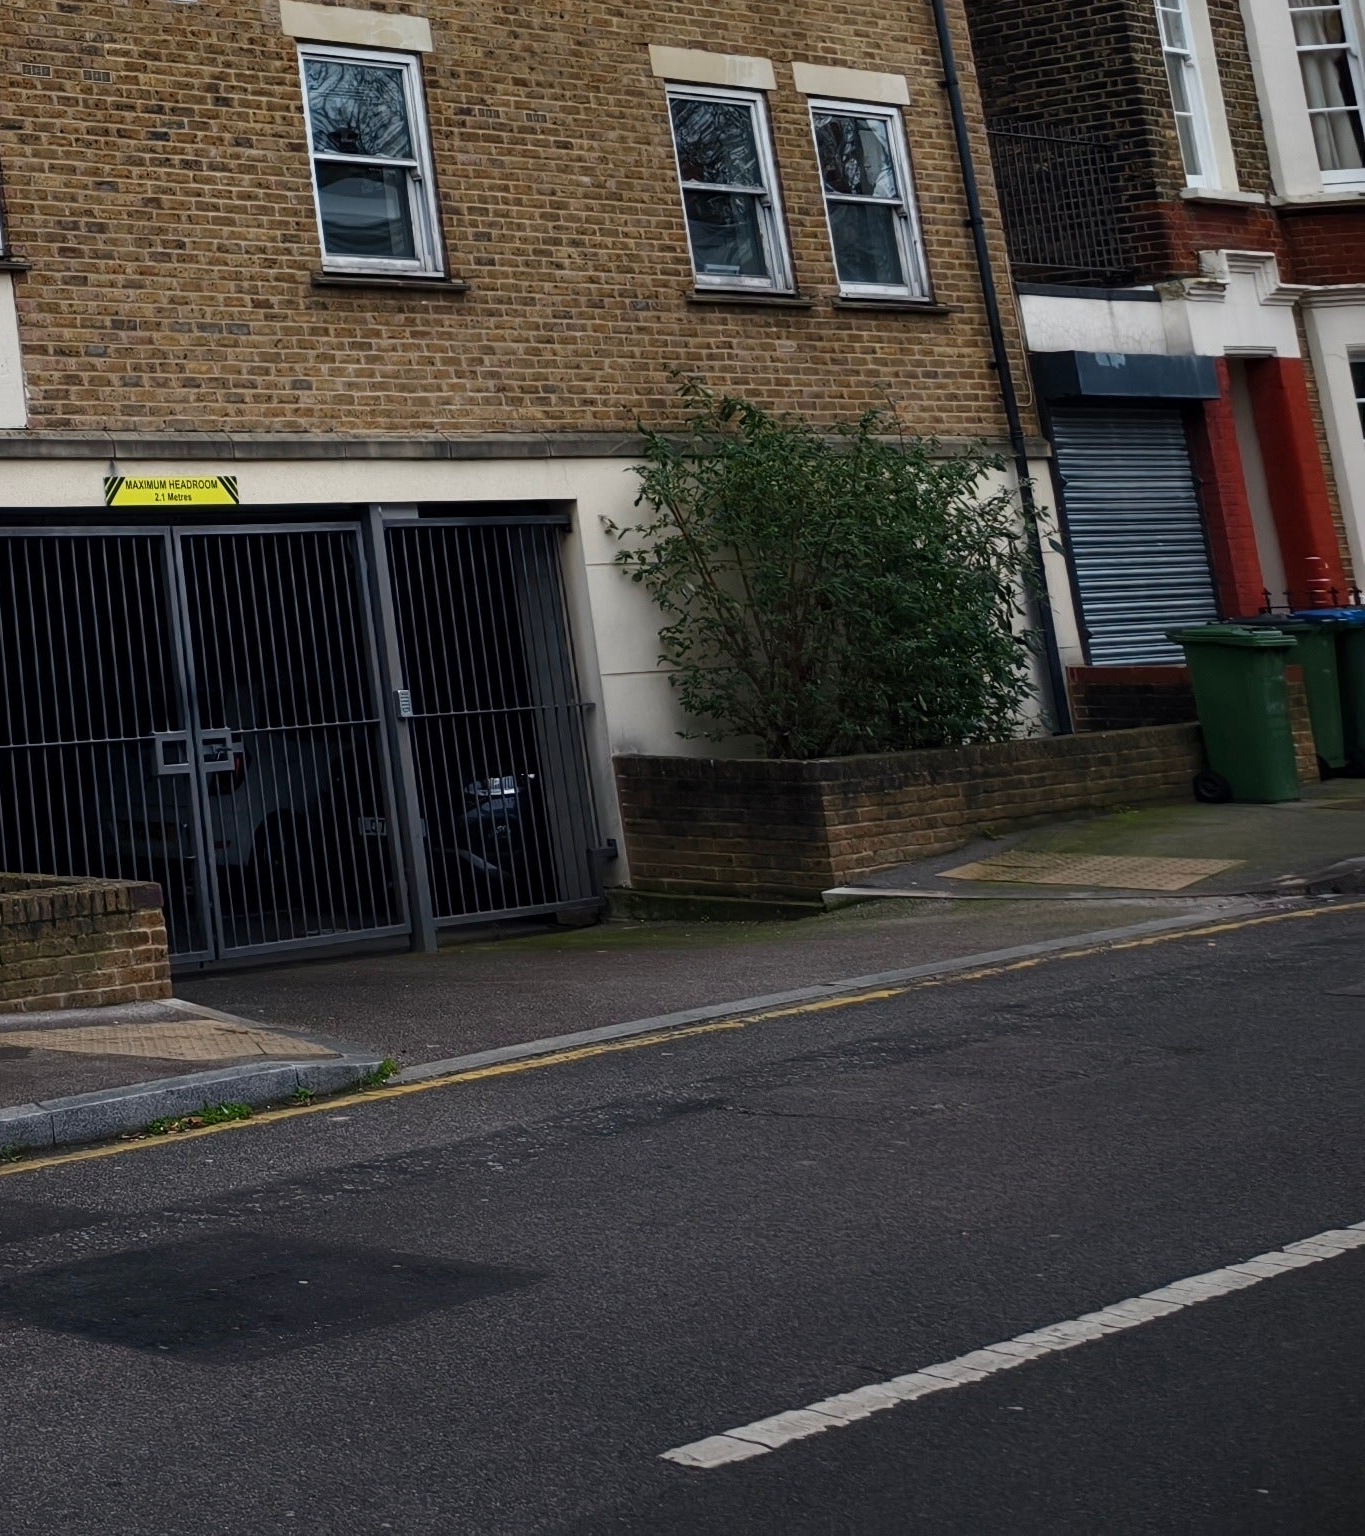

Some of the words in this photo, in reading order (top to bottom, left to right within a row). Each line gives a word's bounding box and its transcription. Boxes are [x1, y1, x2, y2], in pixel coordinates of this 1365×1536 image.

[125, 480, 167, 490] MAXIMUM
[168, 480, 218, 490] HEADROOM
[154, 493, 165, 502] 2.1
[167, 492, 192, 502] Metres
